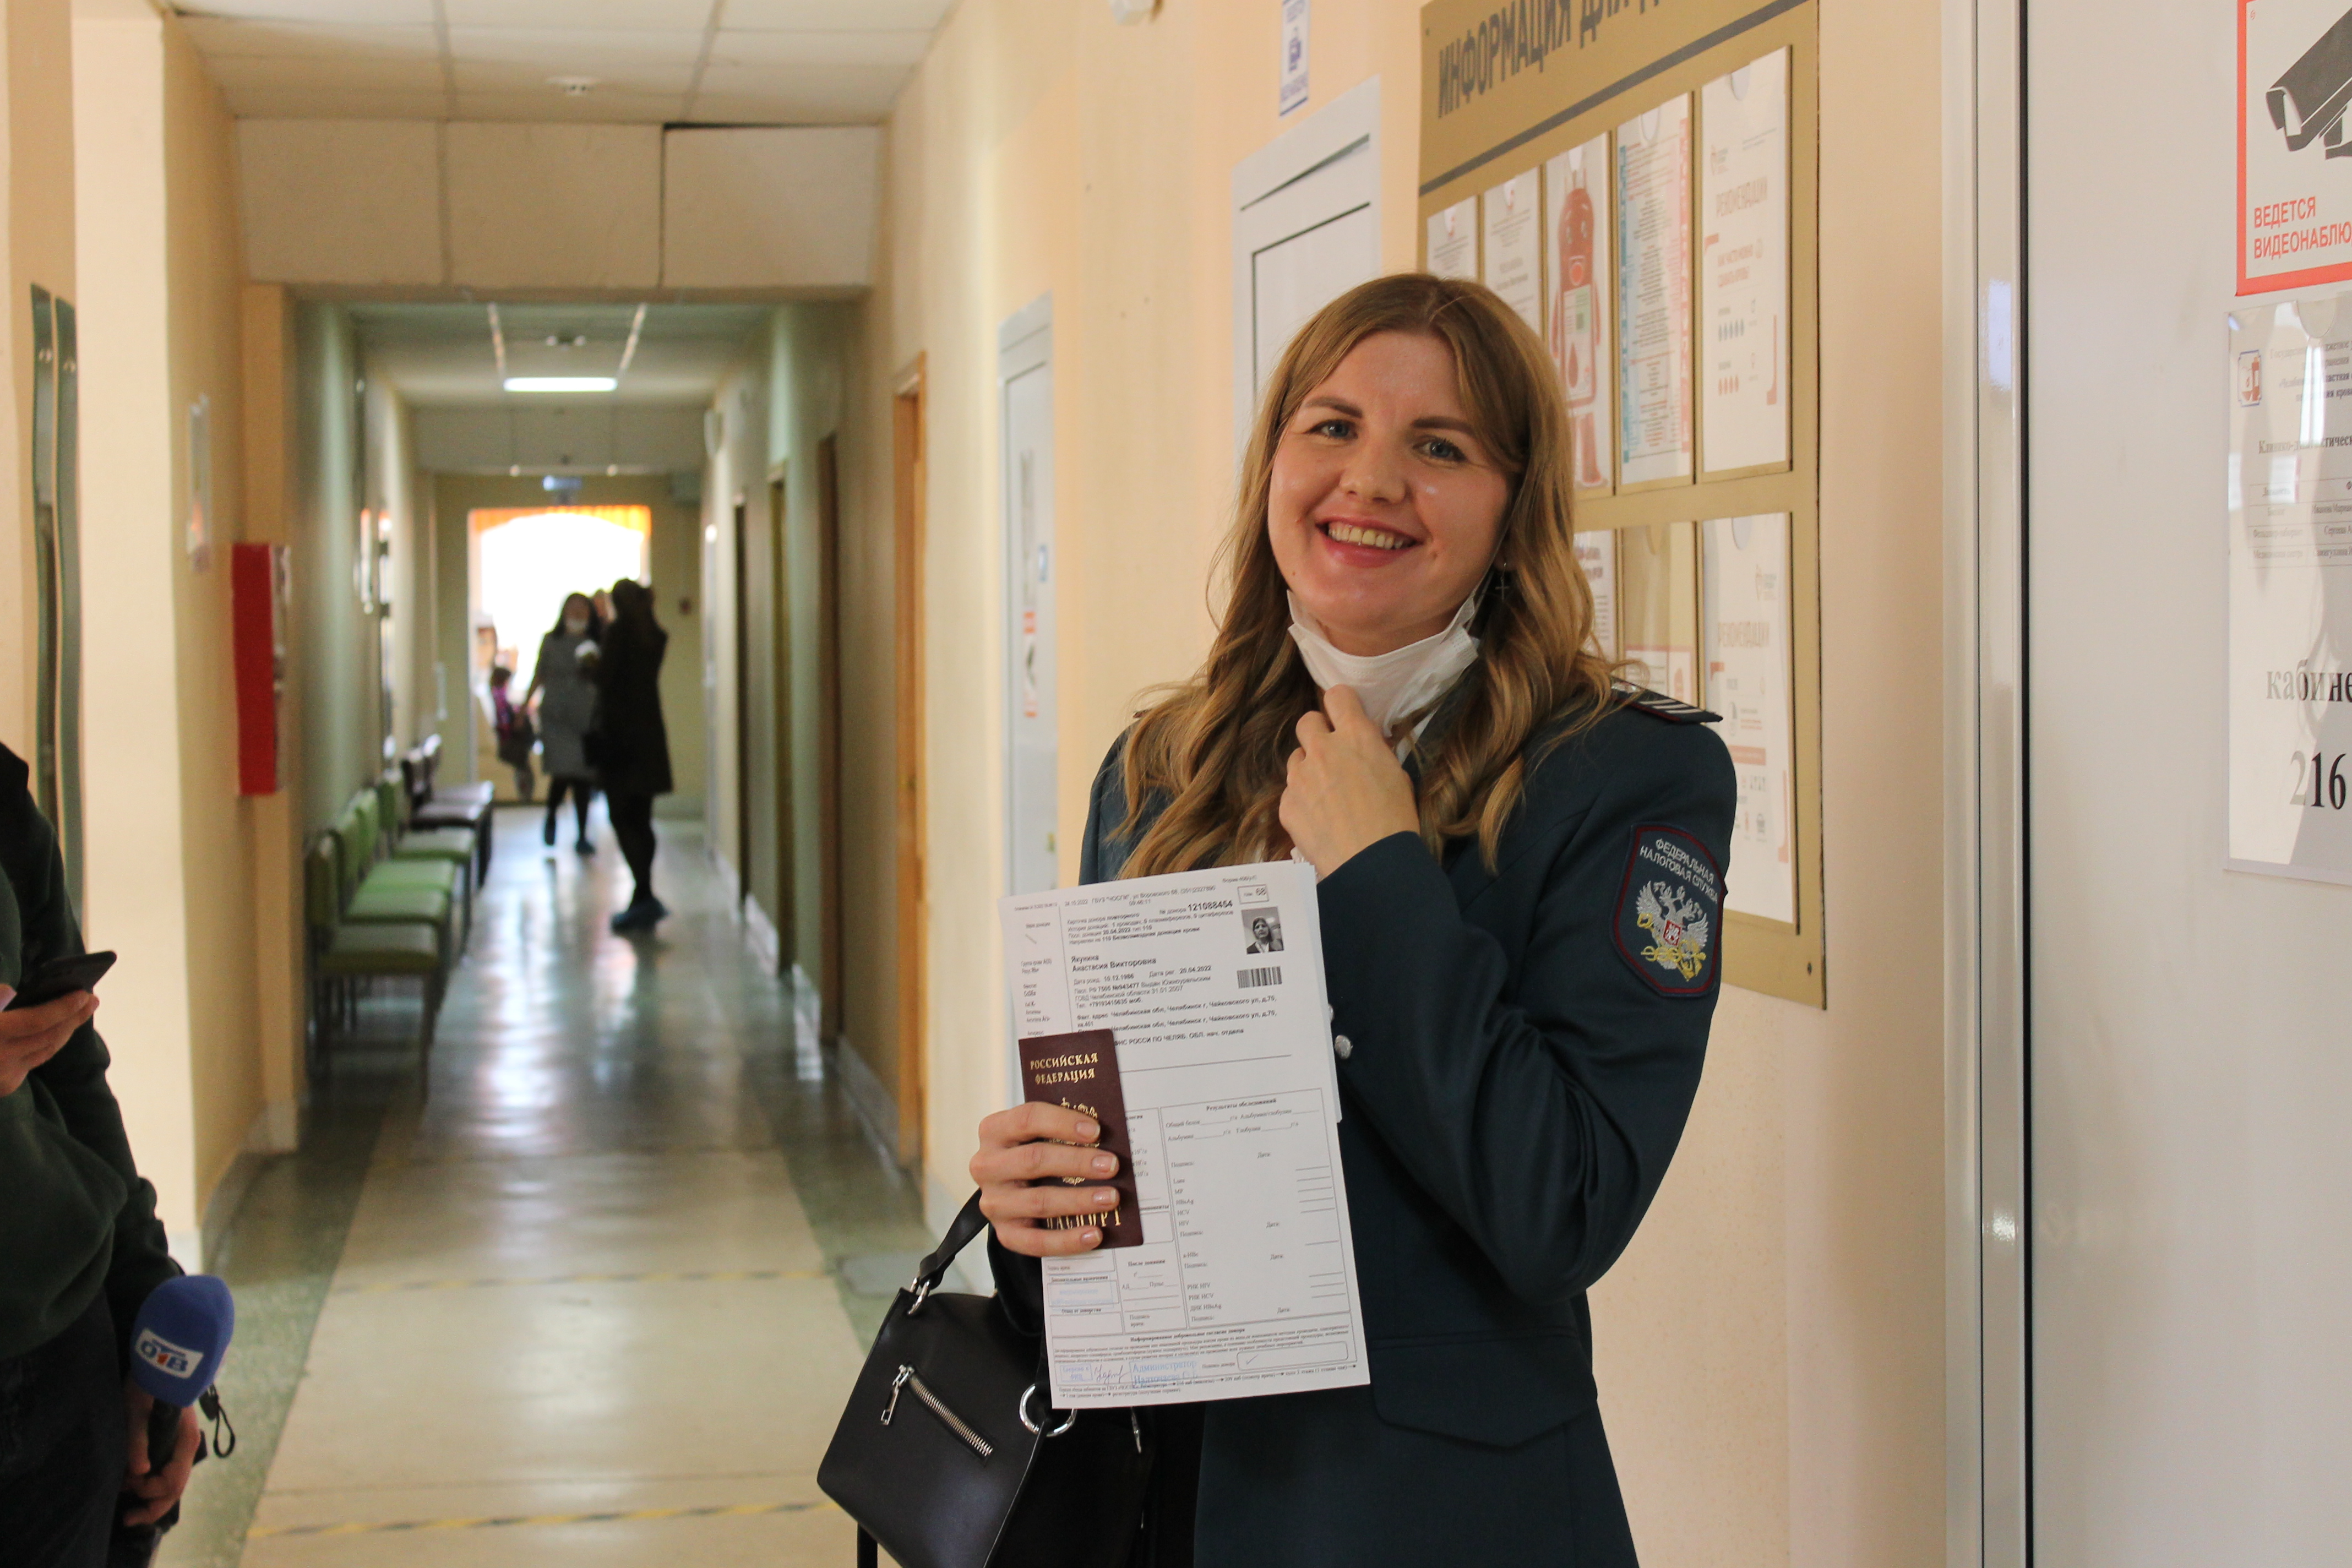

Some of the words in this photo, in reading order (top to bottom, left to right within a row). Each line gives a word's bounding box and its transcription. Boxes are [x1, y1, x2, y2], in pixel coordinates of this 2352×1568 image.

[1438, 0, 1571, 119] ИНФОРМАЦИЯ
[2255, 196, 2316, 229] ВЕДЕТСЯ
[2255, 221, 2352, 260] ВИДЕОНАБЛЮ
[2266, 660, 2352, 703] кабине
[2290, 750, 2346, 809] 216
[1640, 846, 1691, 881] НАЛОГОВАЯ
[1692, 874, 1718, 905] СЛУЖБА
[1656, 839, 1715, 885] ФЕДЕРАЛЬНАЯ
[1072, 963, 1108, 972] Анастасия
[1110, 959, 1156, 968] Викторовна
[1030, 1052, 1099, 1070] РОССИЙСКАЯ
[1035, 1068, 1096, 1085] ФЕДЕРАЦИЯ
